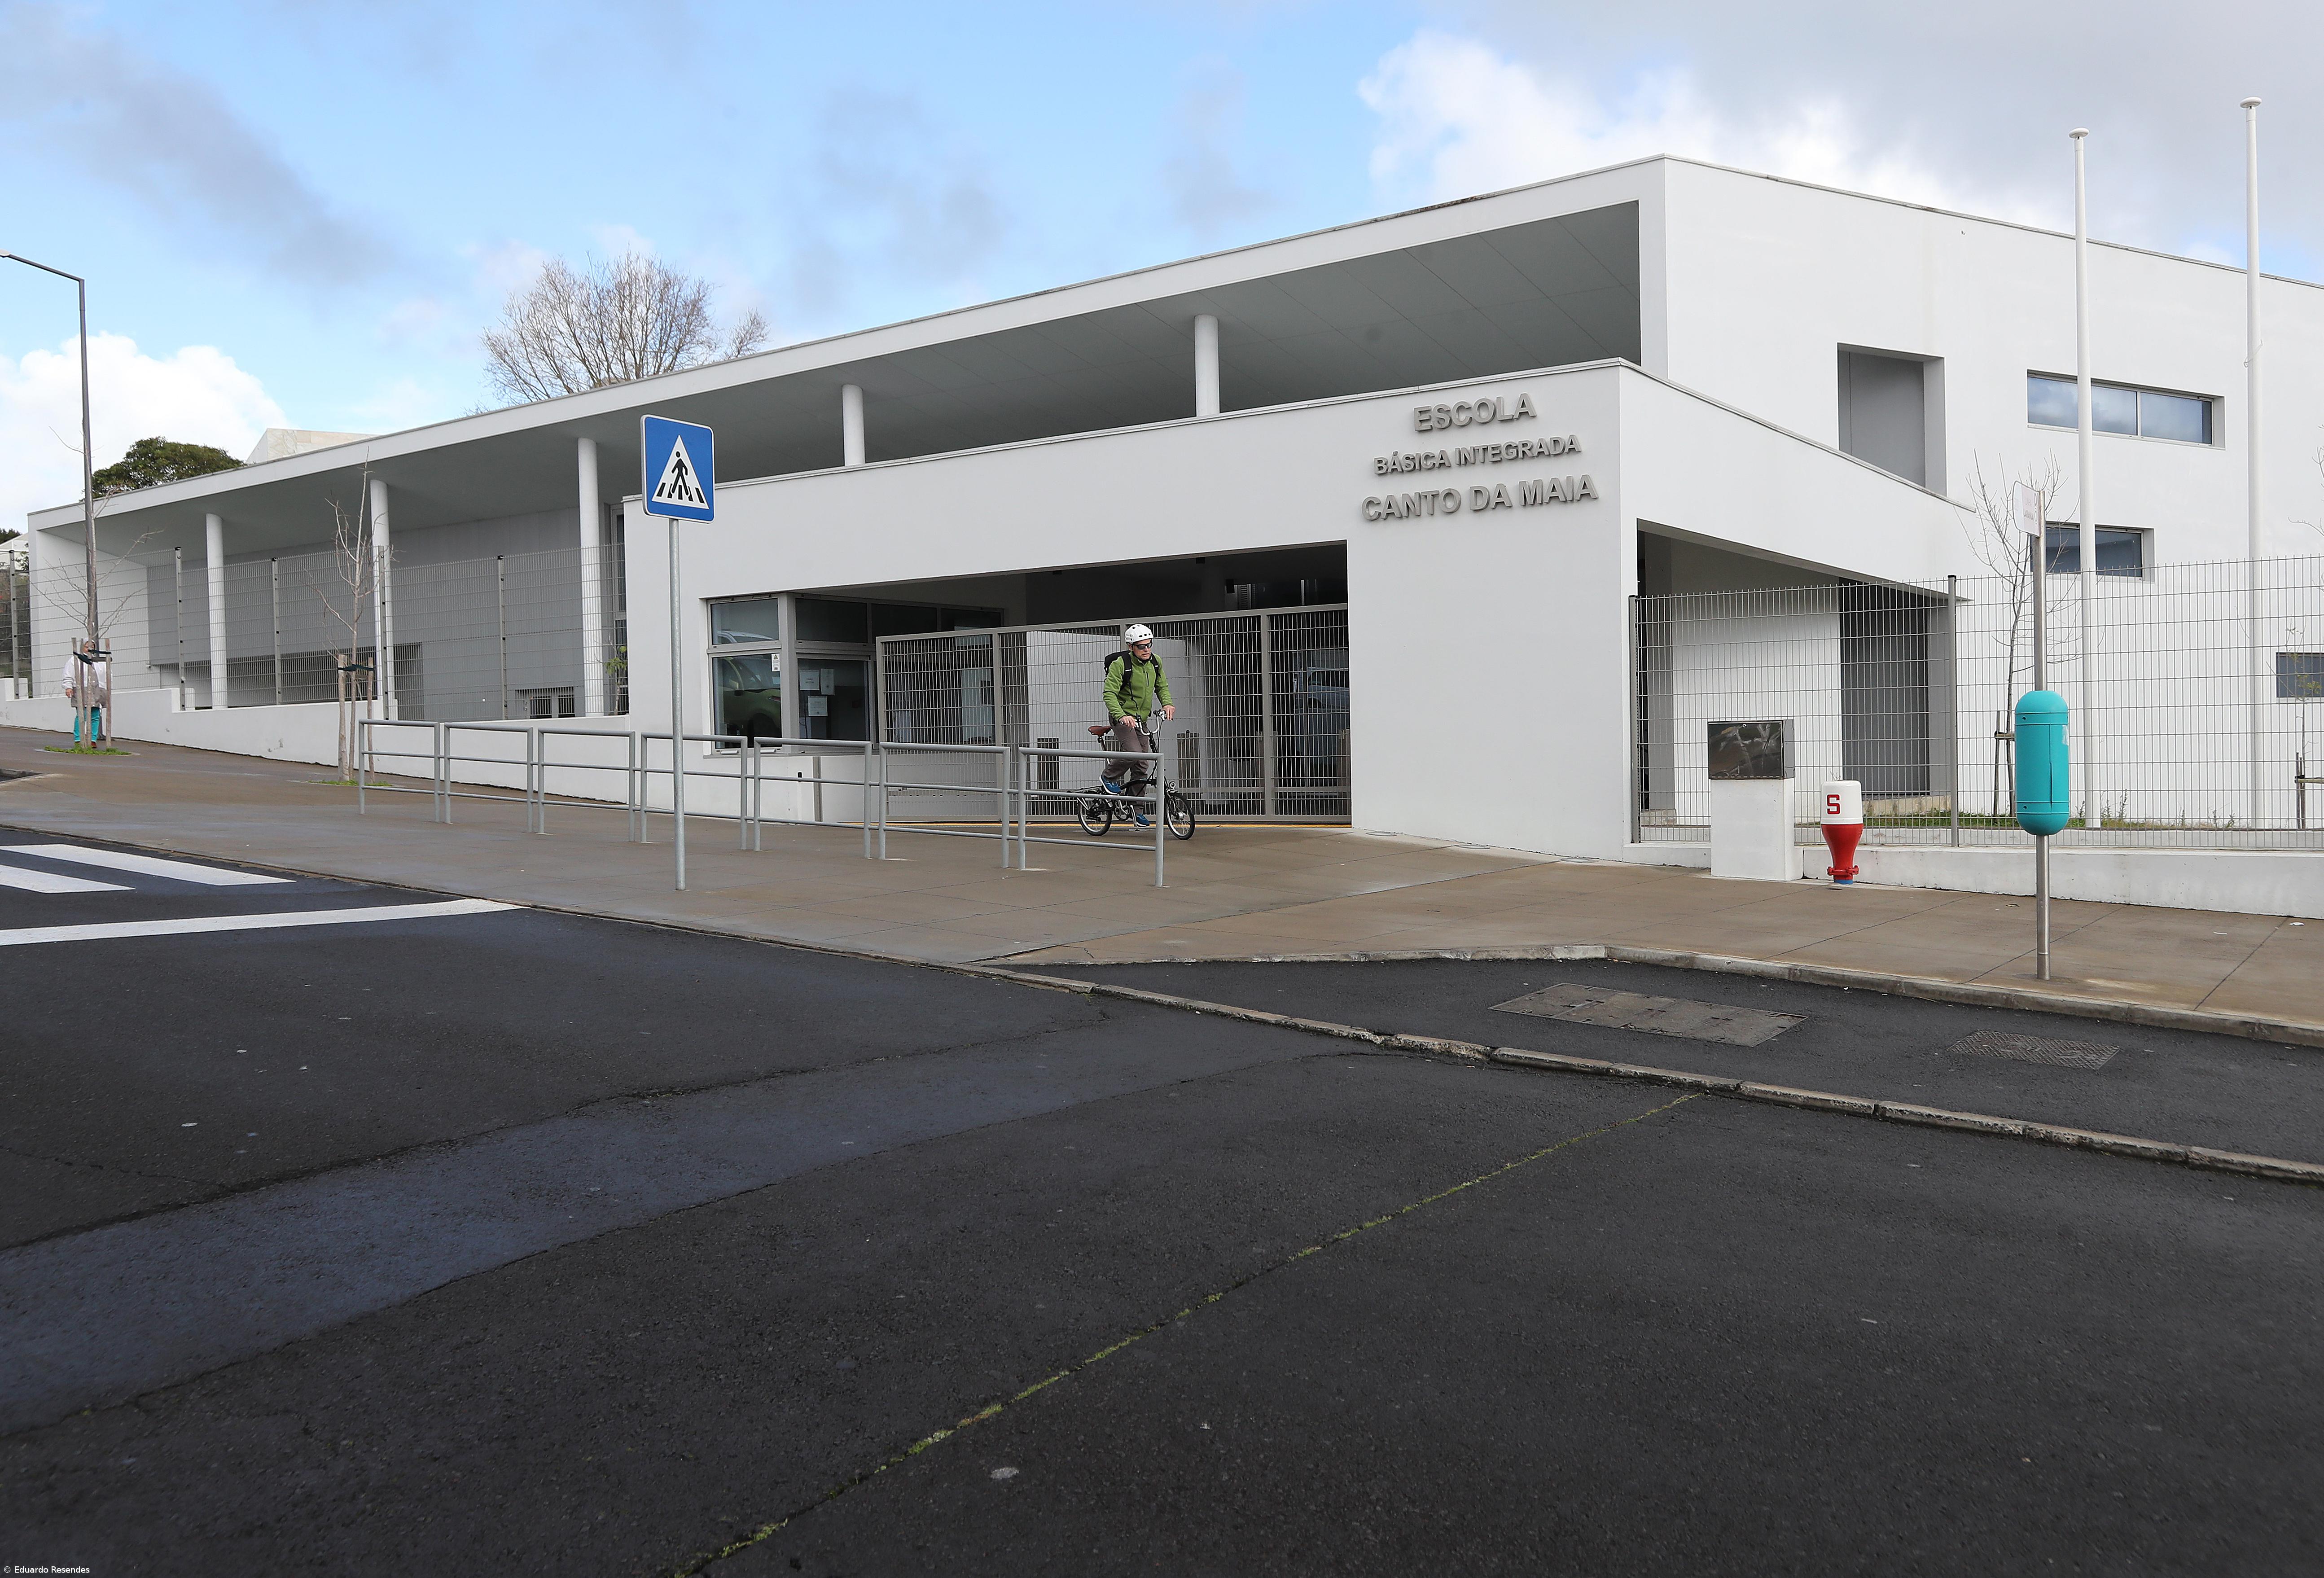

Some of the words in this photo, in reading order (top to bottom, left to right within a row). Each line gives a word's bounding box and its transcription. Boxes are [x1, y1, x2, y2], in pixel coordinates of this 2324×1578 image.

[1413, 392, 1537, 432] ESCOLA
[1374, 450, 1451, 475] BÁSICA
[1455, 434, 1582, 465] INTEGRADA
[1362, 487, 1461, 521] CANTO
[1469, 483, 1513, 511] DA
[1519, 474, 1599, 506] MAIA
